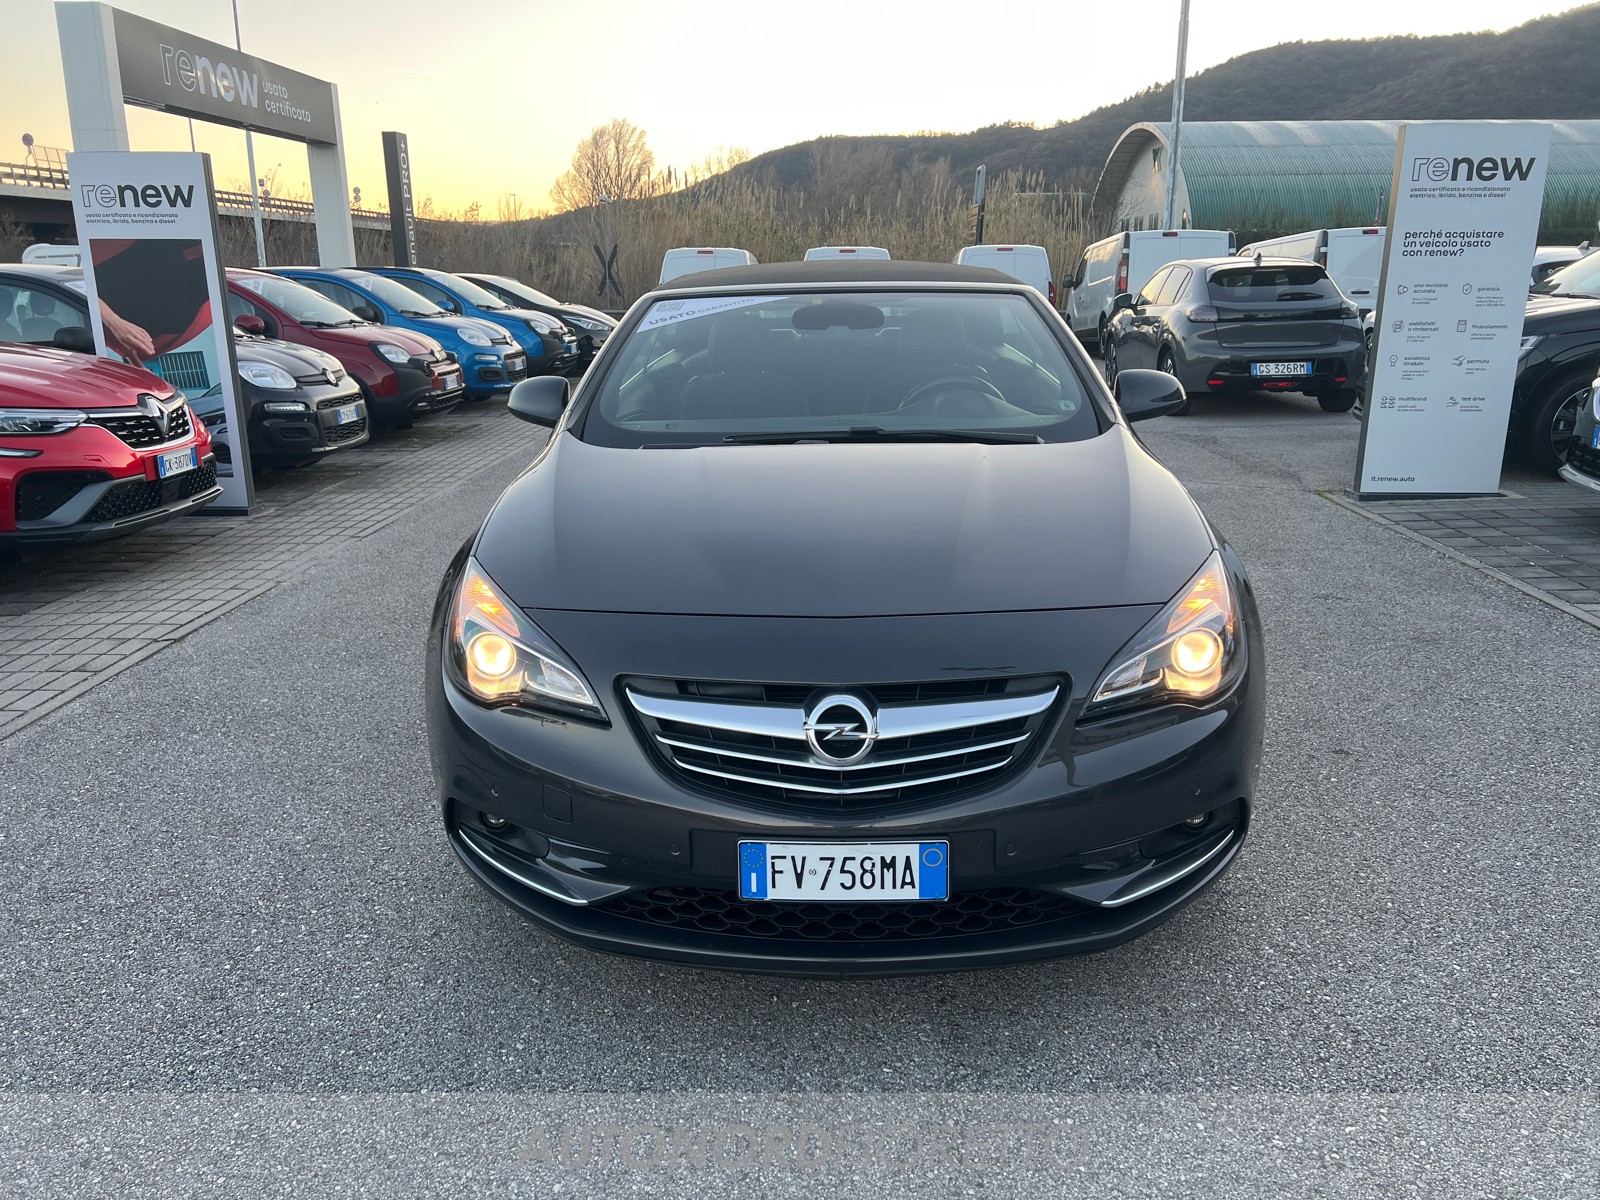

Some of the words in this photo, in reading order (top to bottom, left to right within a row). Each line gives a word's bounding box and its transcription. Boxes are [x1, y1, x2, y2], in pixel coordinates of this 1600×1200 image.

[160, 43, 259, 109] renew
[262, 80, 288, 99] usato
[265, 99, 311, 123] certificato
[400, 140, 411, 199] PRO+
[1411, 157, 1536, 182] renew
[81, 184, 194, 208] renew
[405, 204, 417, 268] enault
[1403, 240, 1417, 248] un
[1418, 239, 1458, 248] veicolo
[1460, 240, 1491, 248] usato
[1404, 229, 1443, 240] perché
[1444, 229, 1505, 240] acquistare
[1402, 249, 1423, 257] con
[1424, 248, 1464, 257] renew?
[649, 310, 696, 325] USATO
[698, 298, 755, 313] GARANTITO
